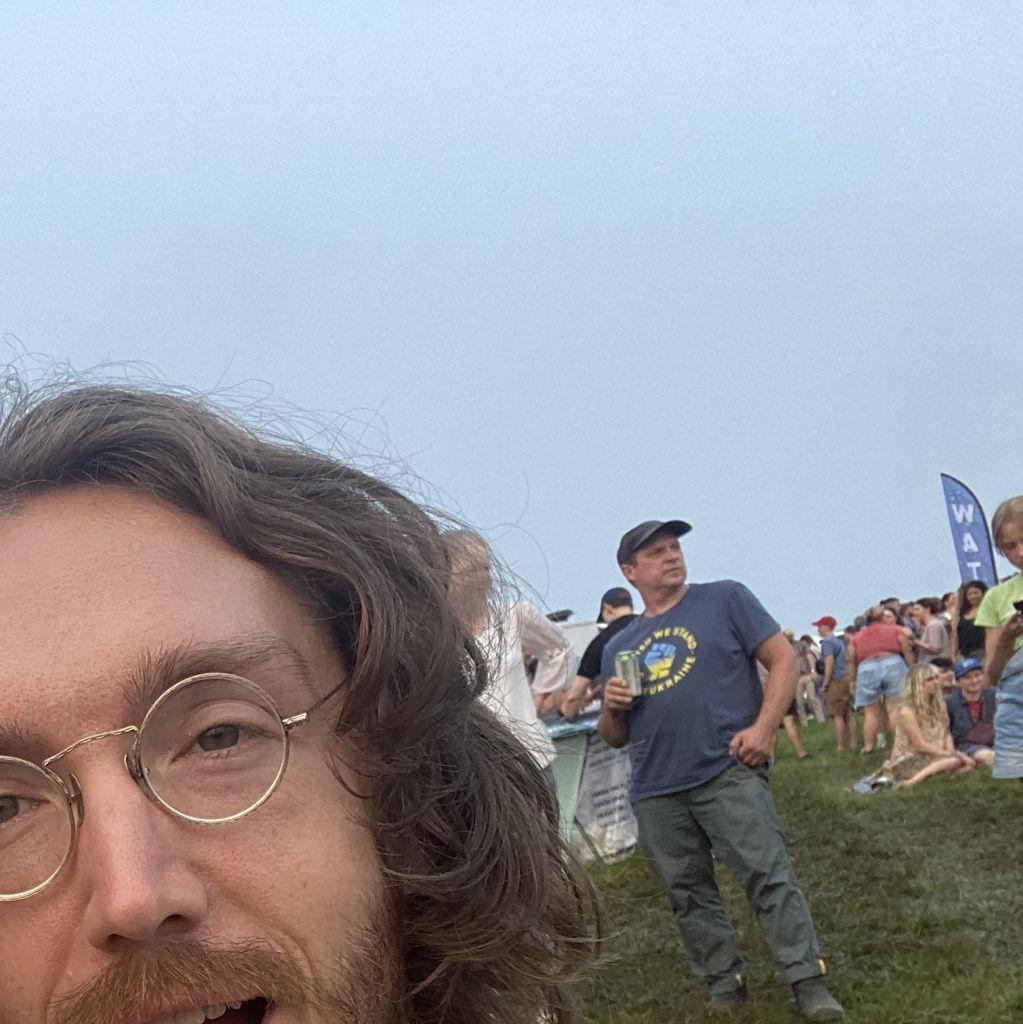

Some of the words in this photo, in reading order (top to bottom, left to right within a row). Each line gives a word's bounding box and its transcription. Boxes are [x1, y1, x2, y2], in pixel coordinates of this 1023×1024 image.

[951, 504, 982, 580] WAT
[653, 627, 671, 640] WE
[649, 656, 696, 695] UKRAINE
